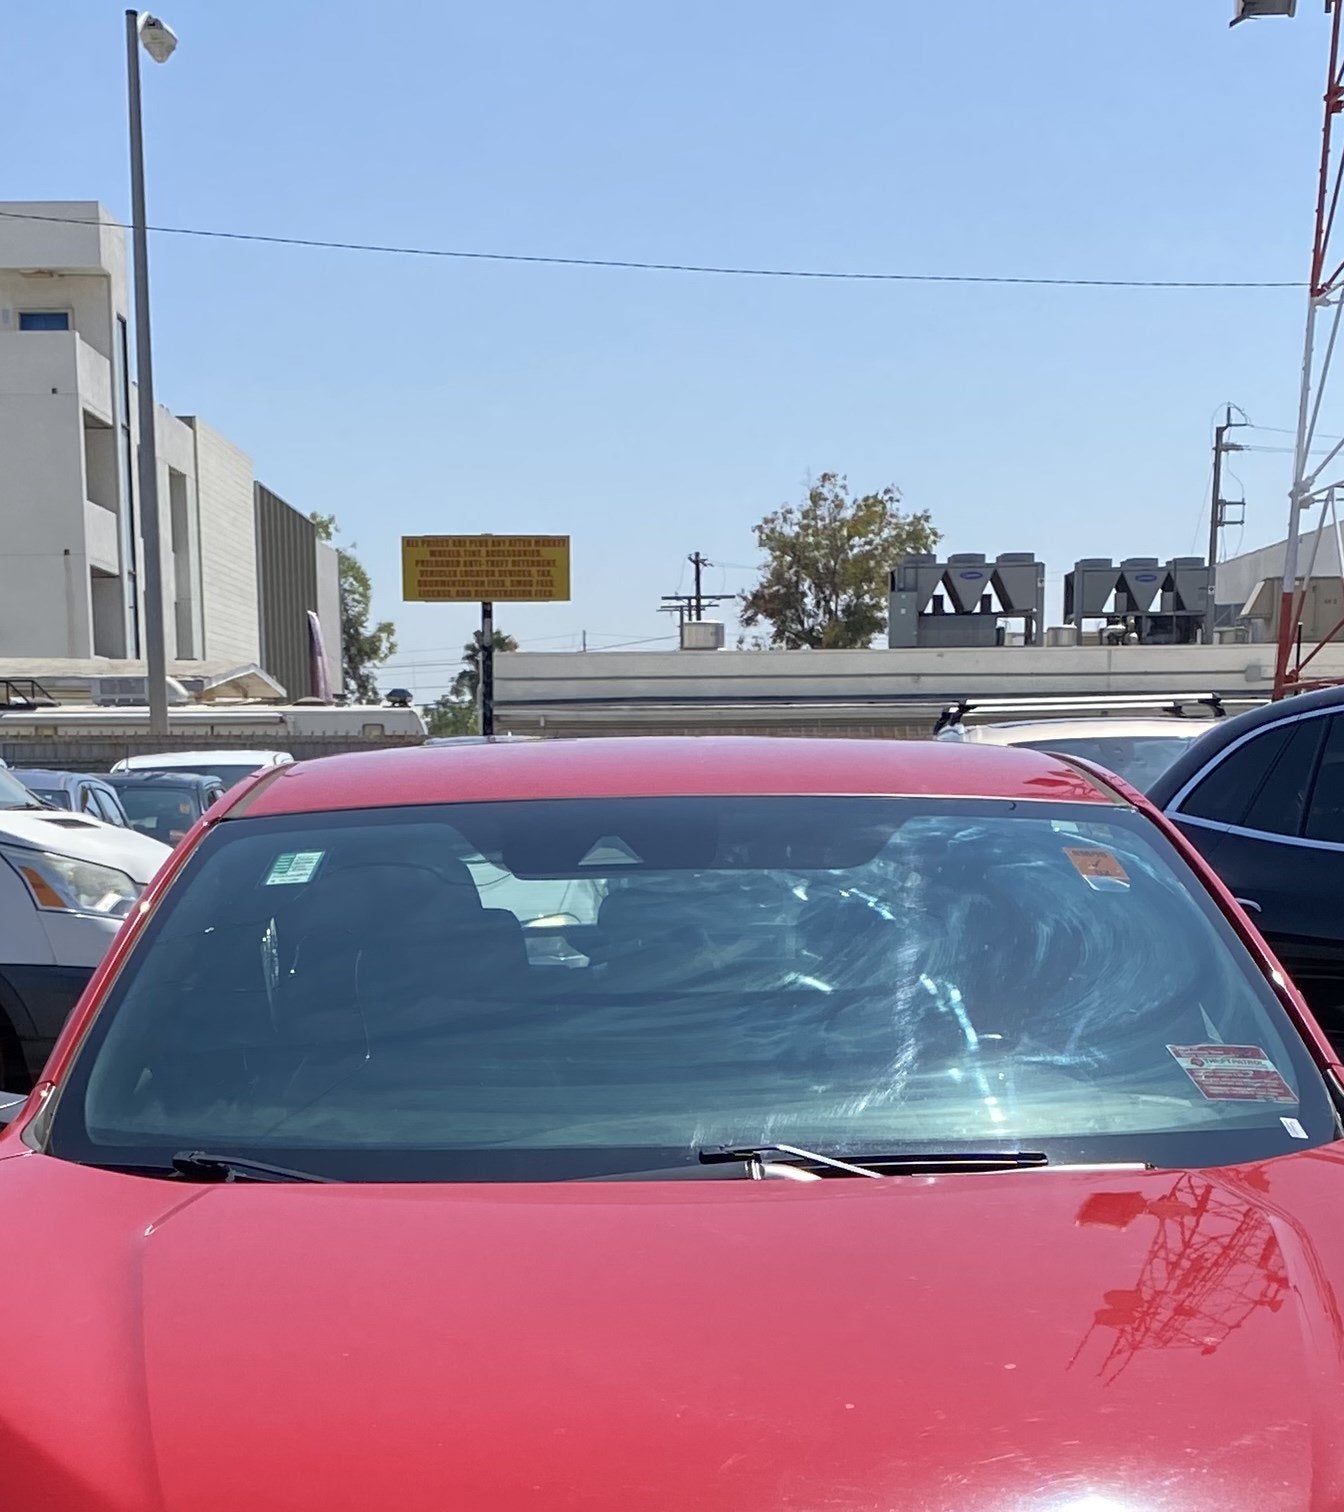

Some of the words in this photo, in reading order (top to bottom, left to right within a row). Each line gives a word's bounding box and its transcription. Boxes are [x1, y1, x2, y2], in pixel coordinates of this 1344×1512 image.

[508, 539, 532, 548] AFTER
[463, 559, 509, 567] ANTI-THEFT
[456, 589, 472, 597] AND
[474, 589, 532, 597] REGISTRATION
